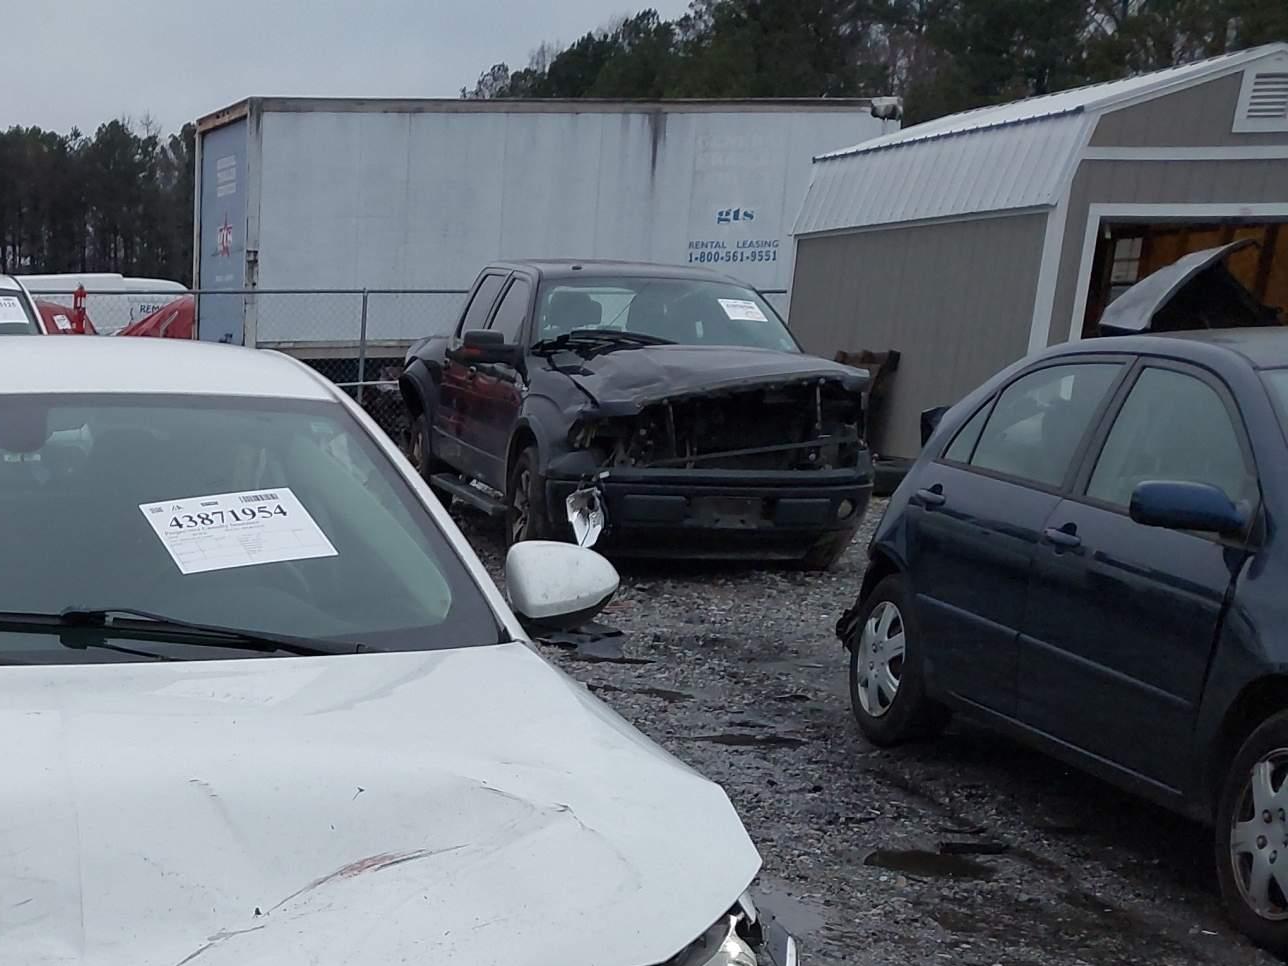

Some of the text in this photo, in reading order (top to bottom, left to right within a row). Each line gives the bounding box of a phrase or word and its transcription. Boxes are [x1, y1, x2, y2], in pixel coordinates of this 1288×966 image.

[716, 208, 754, 224] gts
[688, 240, 779, 249] RENTAL LEASING
[169, 503, 288, 529] 43871954
